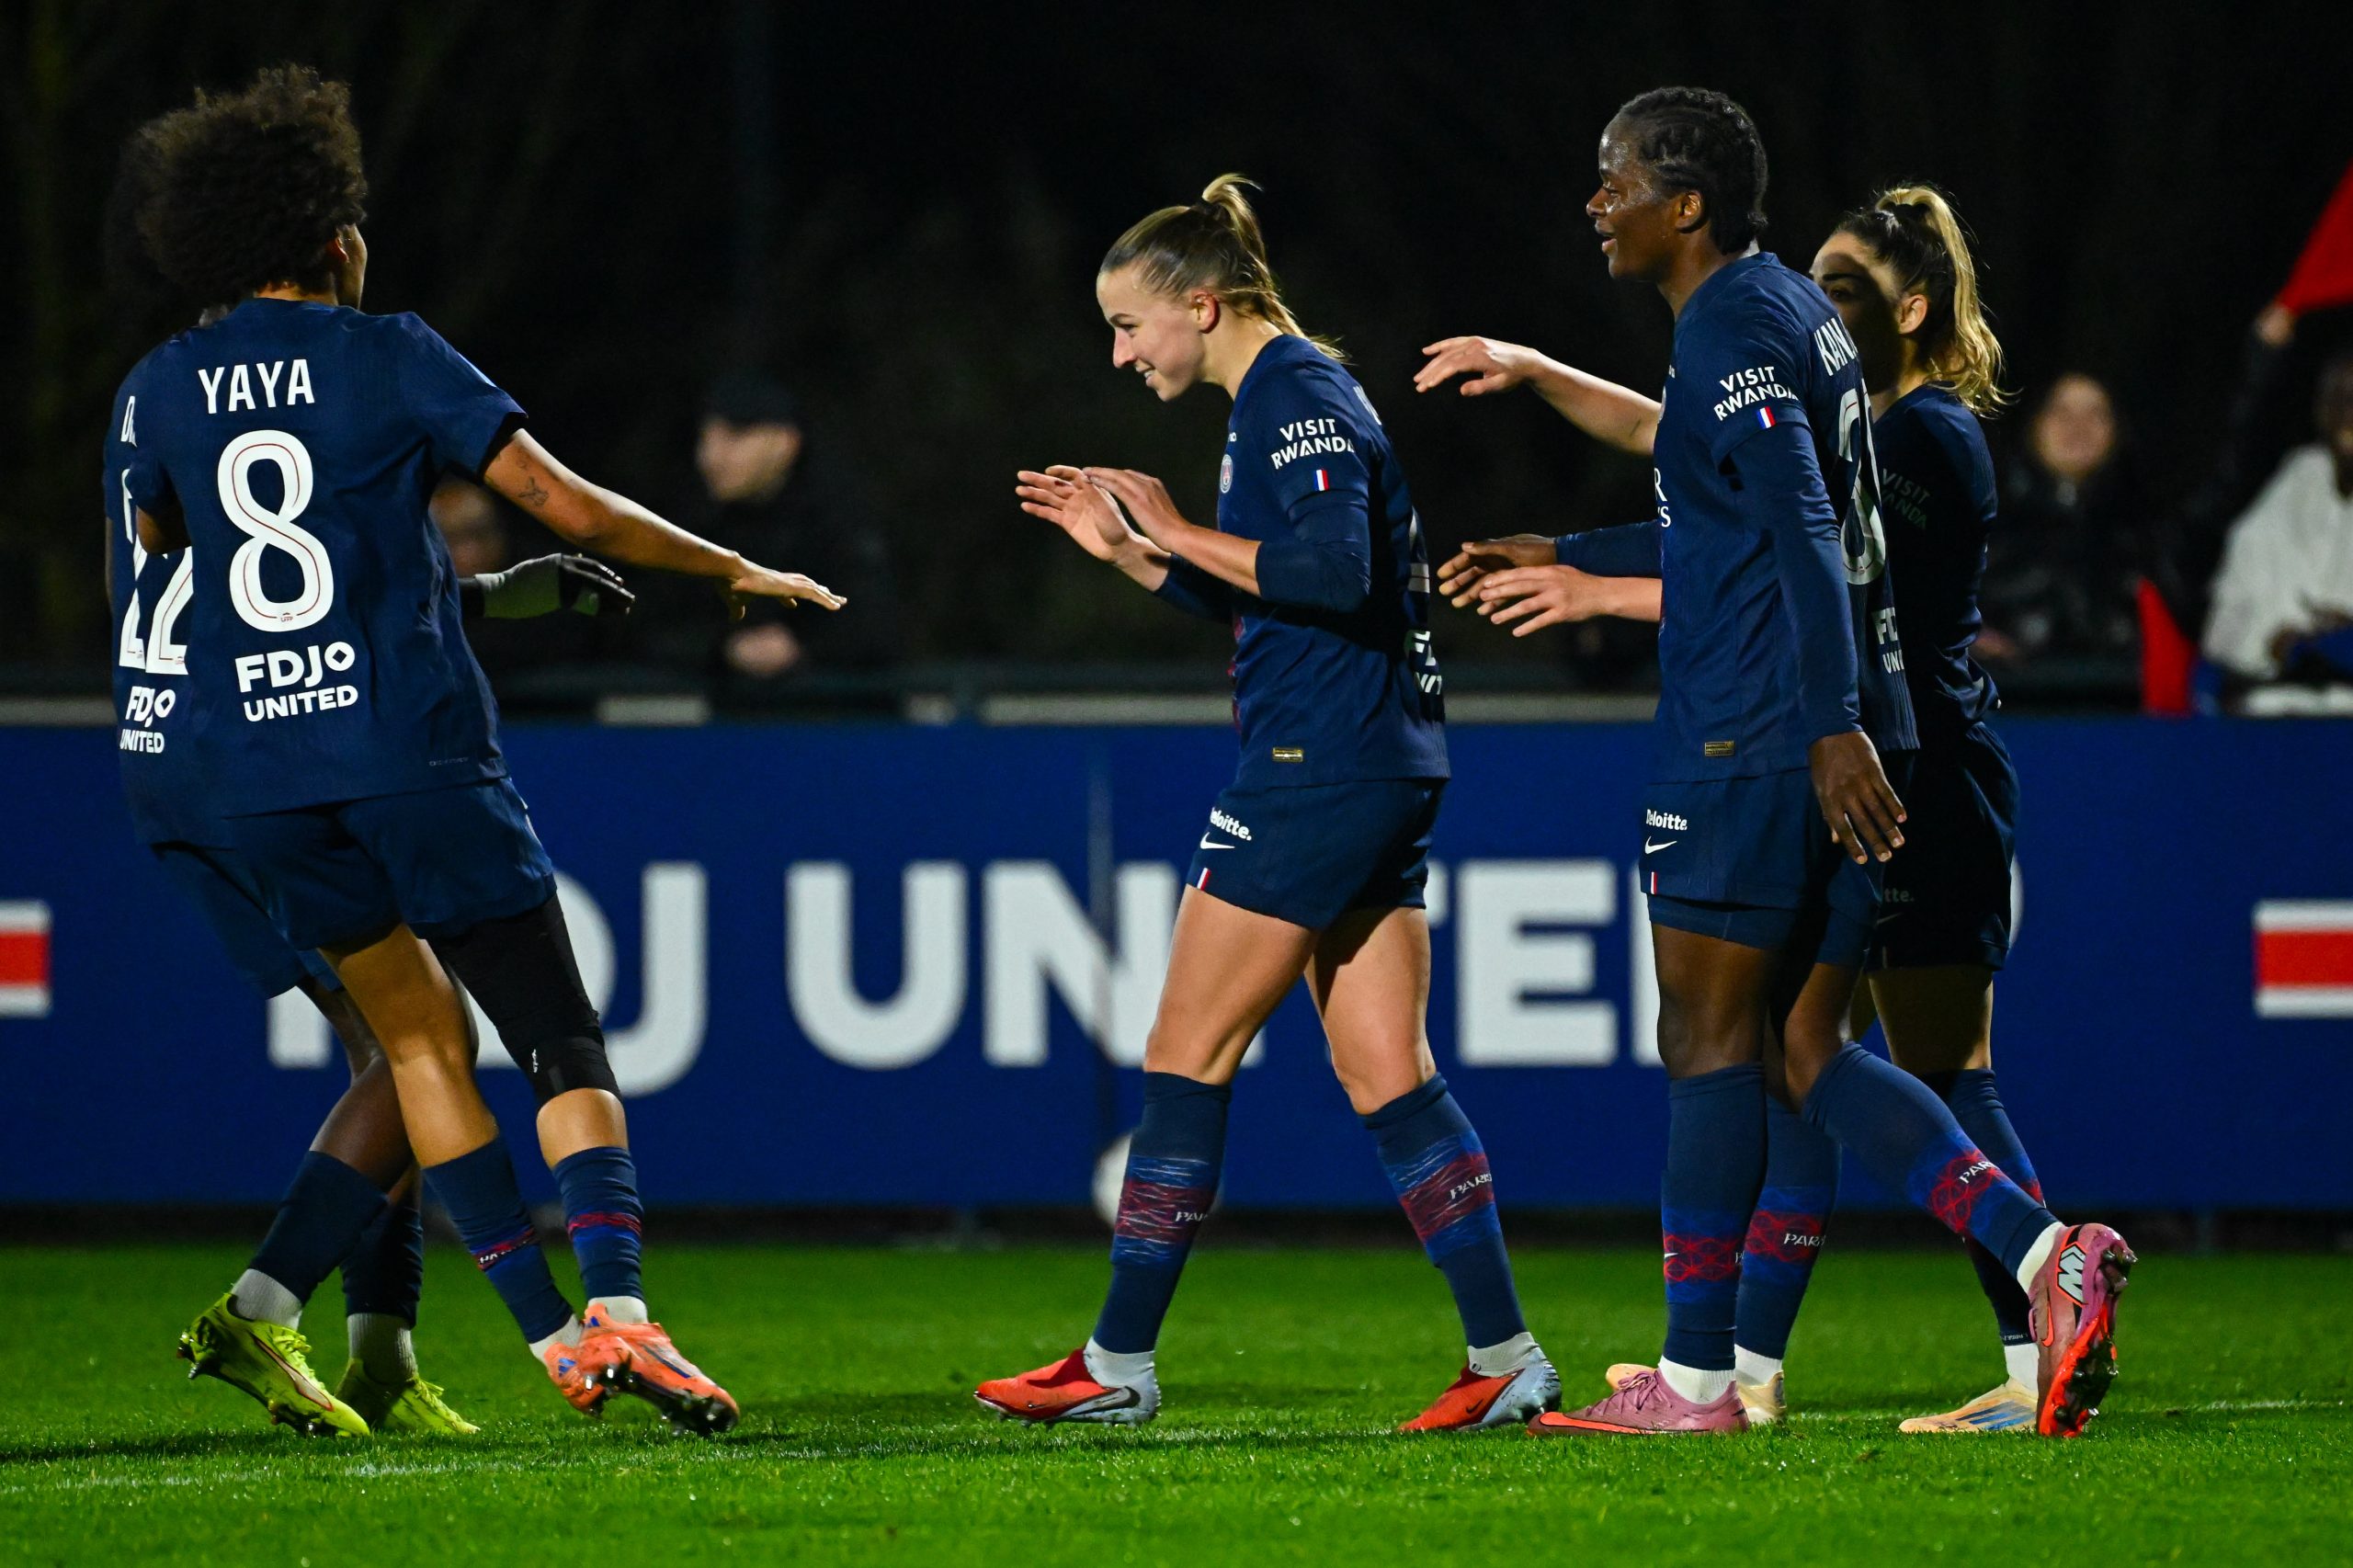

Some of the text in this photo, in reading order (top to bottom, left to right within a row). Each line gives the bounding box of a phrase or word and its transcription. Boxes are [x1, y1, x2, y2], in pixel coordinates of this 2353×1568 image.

[198, 358, 315, 415] YAYA
[1719, 366, 1775, 392] VISIT
[1279, 418, 1336, 441] VISIT
[1883, 468, 1930, 505] VISIT
[217, 429, 334, 632] 8
[244, 685, 358, 722] UNITED
[119, 728, 165, 754] UNITED
